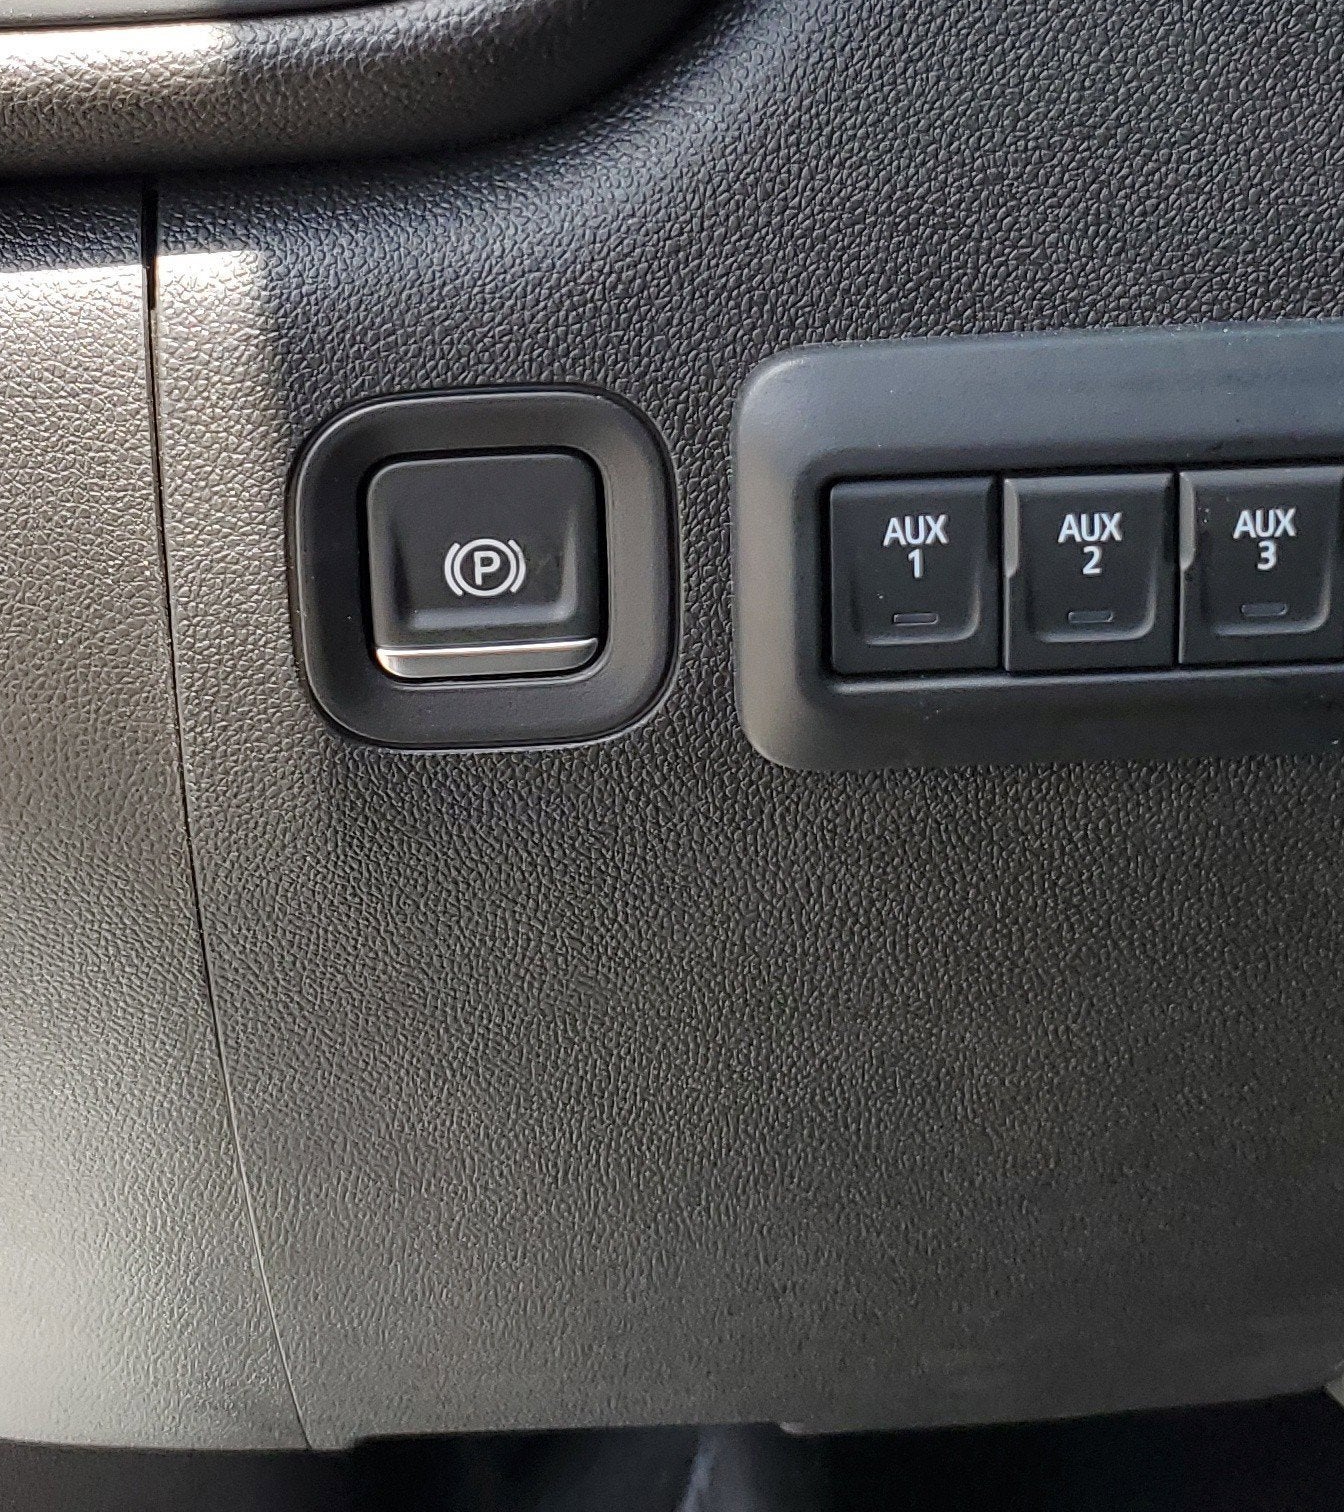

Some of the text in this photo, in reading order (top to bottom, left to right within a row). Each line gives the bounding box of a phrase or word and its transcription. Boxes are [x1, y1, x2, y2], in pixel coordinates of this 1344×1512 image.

[882, 513, 949, 547] AUX
[1057, 512, 1123, 544] AUX
[1232, 506, 1297, 540] AUX
[473, 550, 501, 586] P
[906, 548, 923, 579] 1
[1081, 544, 1103, 576] 2
[1256, 538, 1278, 571] 3
